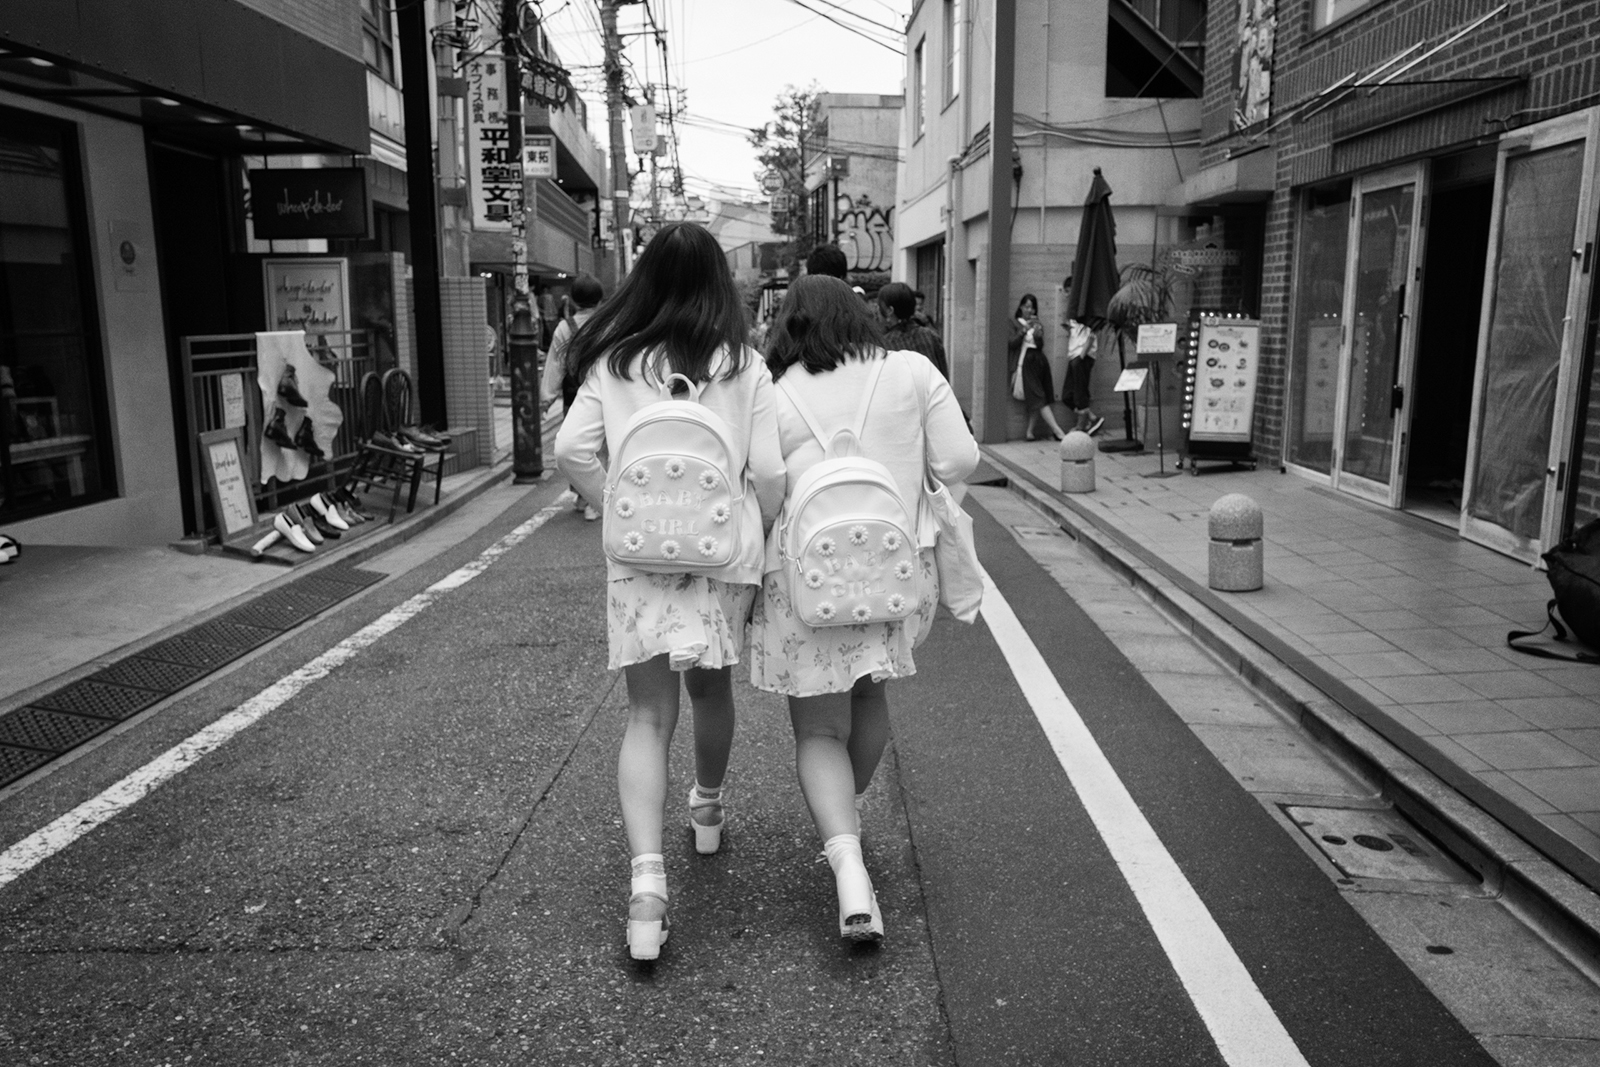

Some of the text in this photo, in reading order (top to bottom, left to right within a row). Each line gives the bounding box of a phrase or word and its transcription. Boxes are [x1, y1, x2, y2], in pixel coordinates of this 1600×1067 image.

[471, 62, 485, 124] オフィス家具
[480, 128, 512, 222] 平和堂文具
[638, 489, 706, 510] BABY
[640, 519, 700, 536] GIRL
[823, 550, 889, 577] BABY
[830, 580, 887, 598] GIRL
